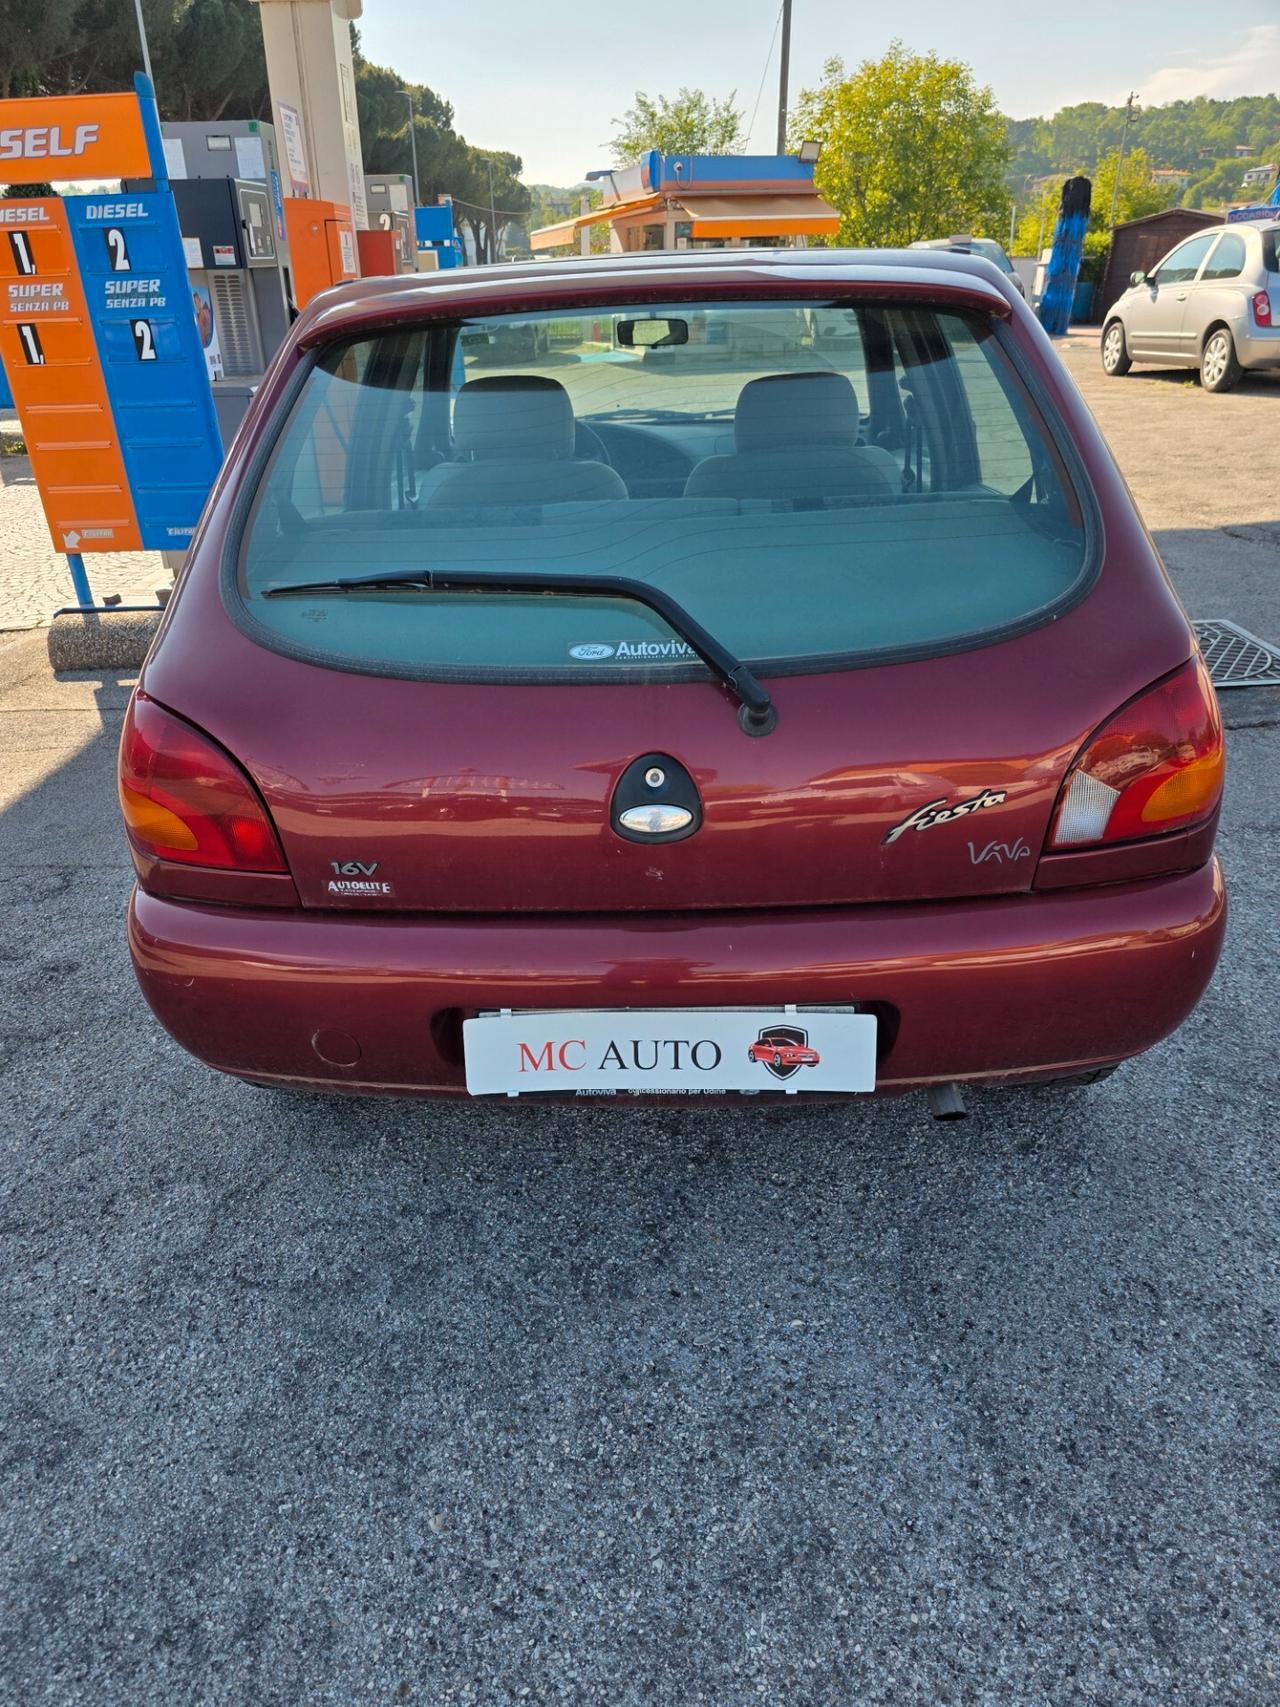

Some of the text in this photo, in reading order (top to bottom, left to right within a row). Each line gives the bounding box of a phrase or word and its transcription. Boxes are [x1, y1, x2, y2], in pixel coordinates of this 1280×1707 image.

[0, 124, 99, 160] SELF
[0, 206, 50, 222] IESEL
[86, 203, 149, 220] DIESEL
[108, 228, 131, 271] 2
[8, 283, 64, 298] SUPER
[105, 279, 161, 294] SUPER
[9, 300, 70, 313] SENZA PB
[106, 297, 167, 309] SENZA PB
[134, 320, 157, 360] 2
[330, 861, 378, 877] 16V
[518, 1040, 722, 1073] MC AUTO
